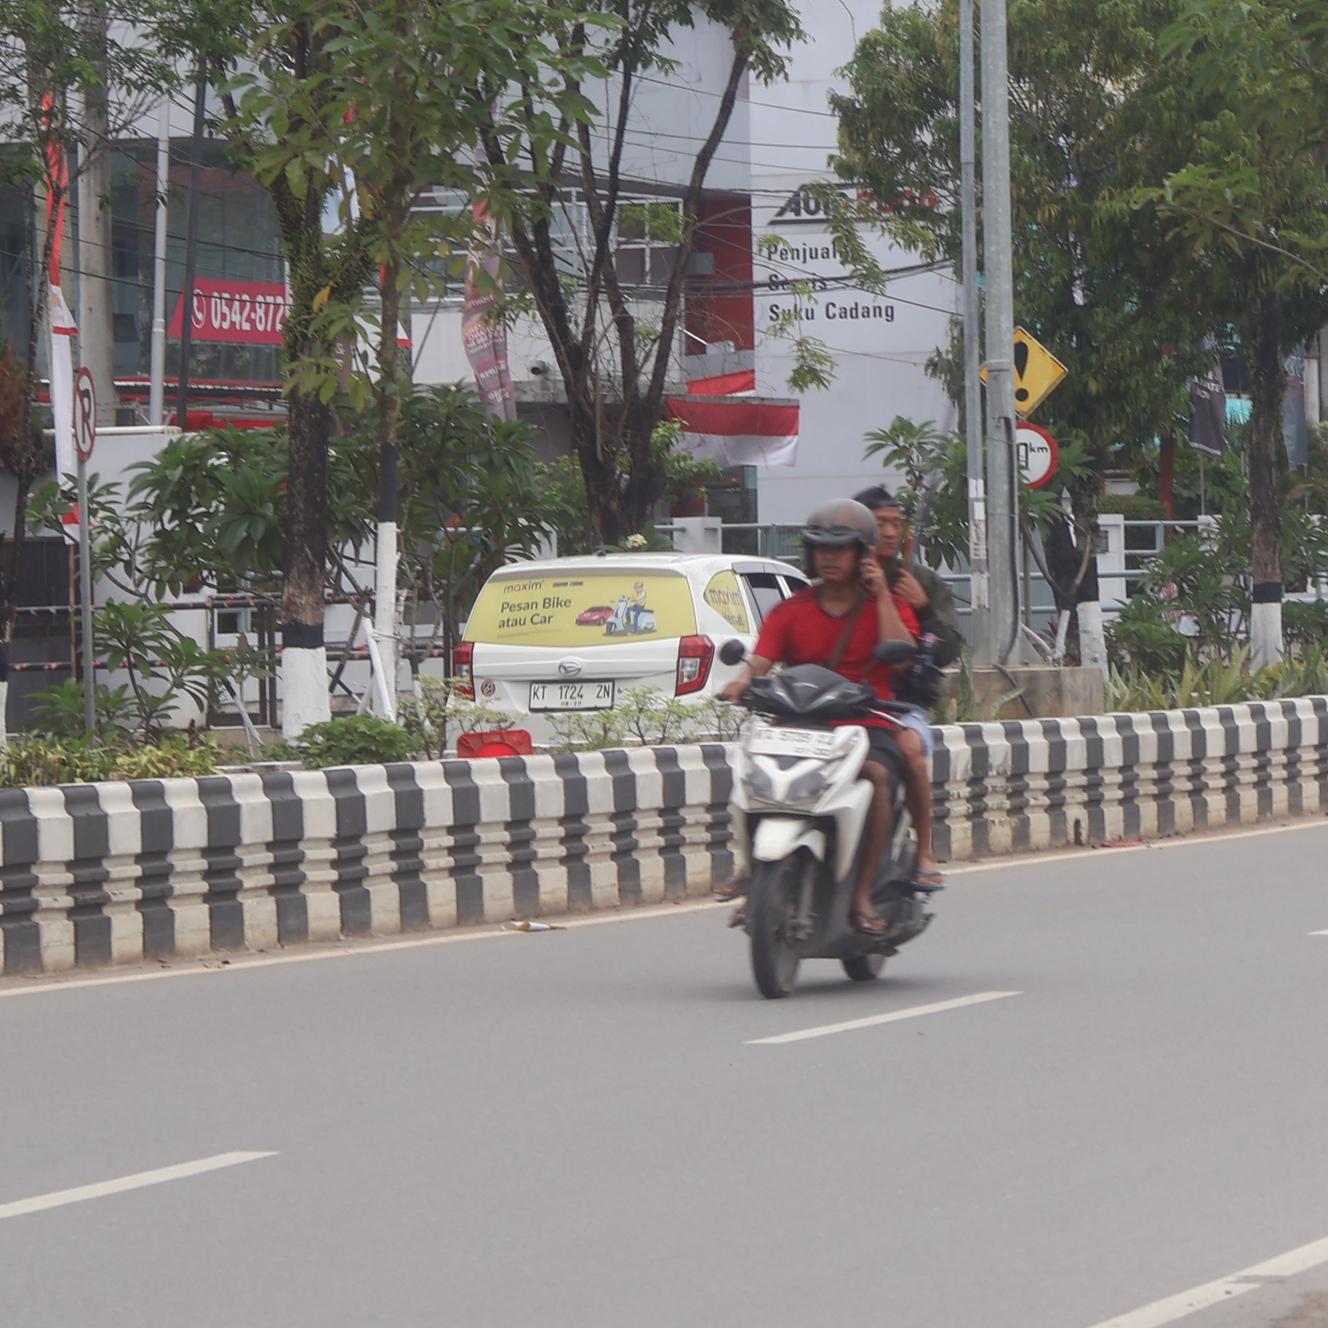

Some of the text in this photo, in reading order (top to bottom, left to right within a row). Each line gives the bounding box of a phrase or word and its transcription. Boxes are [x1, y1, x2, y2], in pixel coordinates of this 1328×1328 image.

[767, 241, 838, 263] Penjual
[211, 291, 288, 332] 0542-872
[769, 301, 896, 322] Suku Cadang
[503, 580, 544, 594] maxim
[501, 596, 572, 613] Pesan Bike
[498, 612, 553, 629] atau Car
[532, 683, 611, 700] KT 1724 ZN
